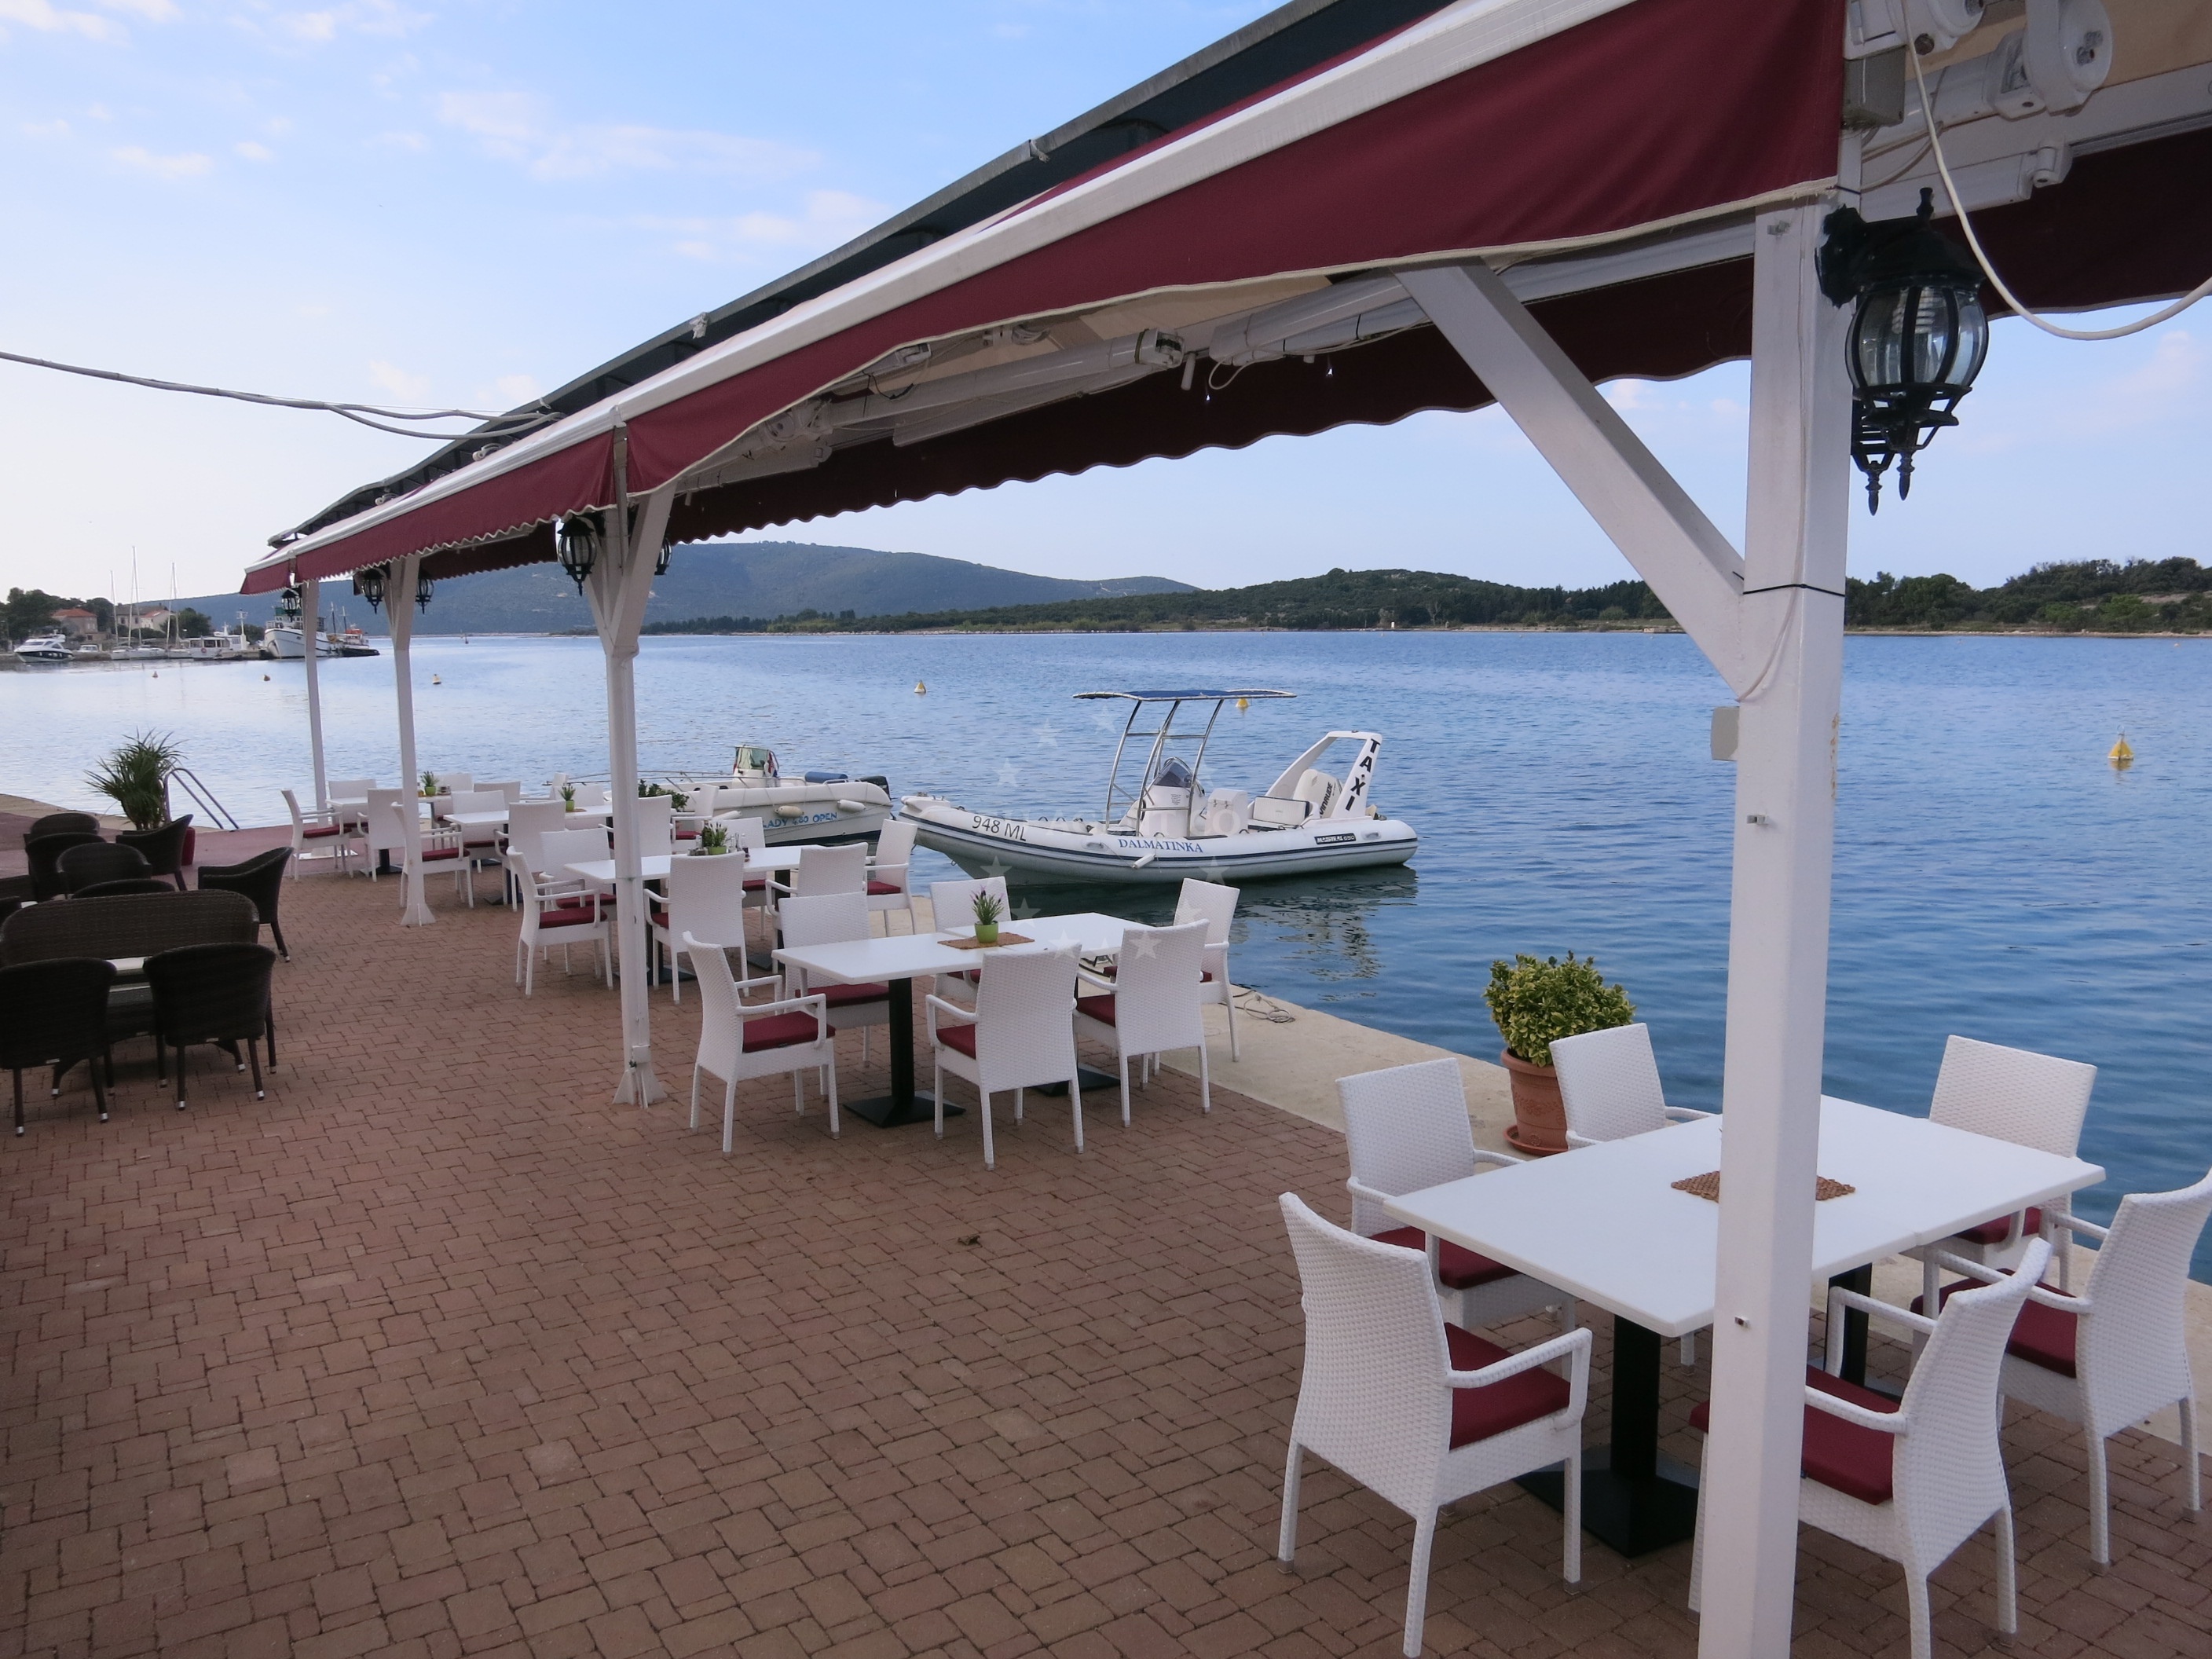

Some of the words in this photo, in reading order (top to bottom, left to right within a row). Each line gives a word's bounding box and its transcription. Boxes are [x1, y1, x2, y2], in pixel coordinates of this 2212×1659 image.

[1346, 738, 1381, 811] TAXI
[1319, 782, 1334, 818] VINRUDE
[812, 812, 837, 823] OPEN
[972, 815, 1001, 833] 948
[1004, 822, 1027, 841] ML
[1118, 839, 1203, 853] DALMATINKA
